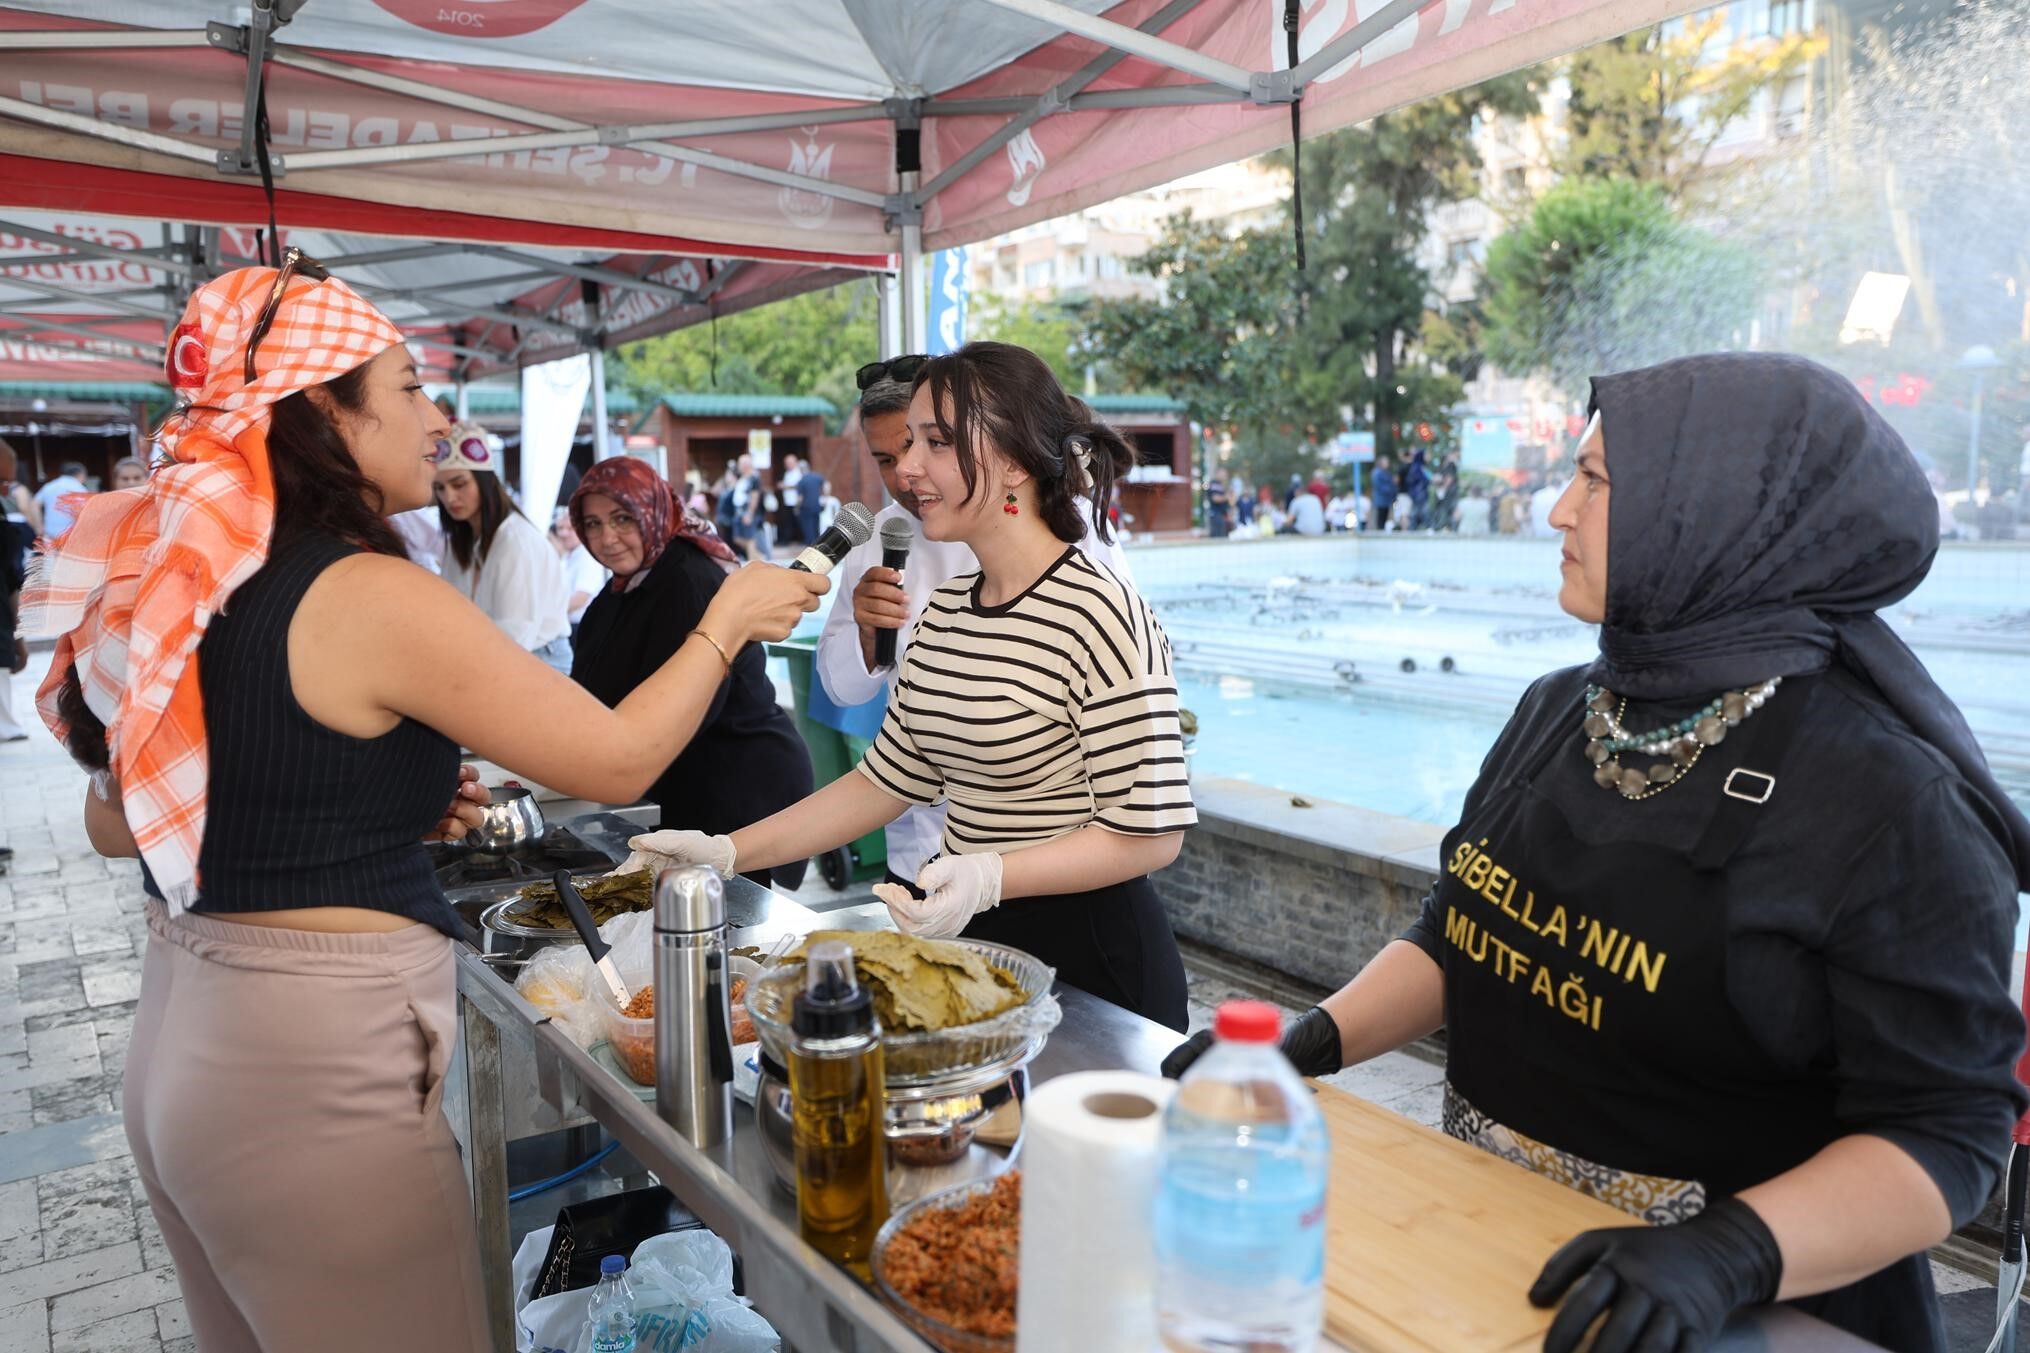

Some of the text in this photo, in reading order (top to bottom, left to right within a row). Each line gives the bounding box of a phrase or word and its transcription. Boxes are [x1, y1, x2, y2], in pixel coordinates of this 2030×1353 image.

[1445, 906, 1603, 1031] MUTFAĞI
[1448, 838, 1667, 993] SİBELLA'NIN
[594, 1341, 626, 1352] damla
